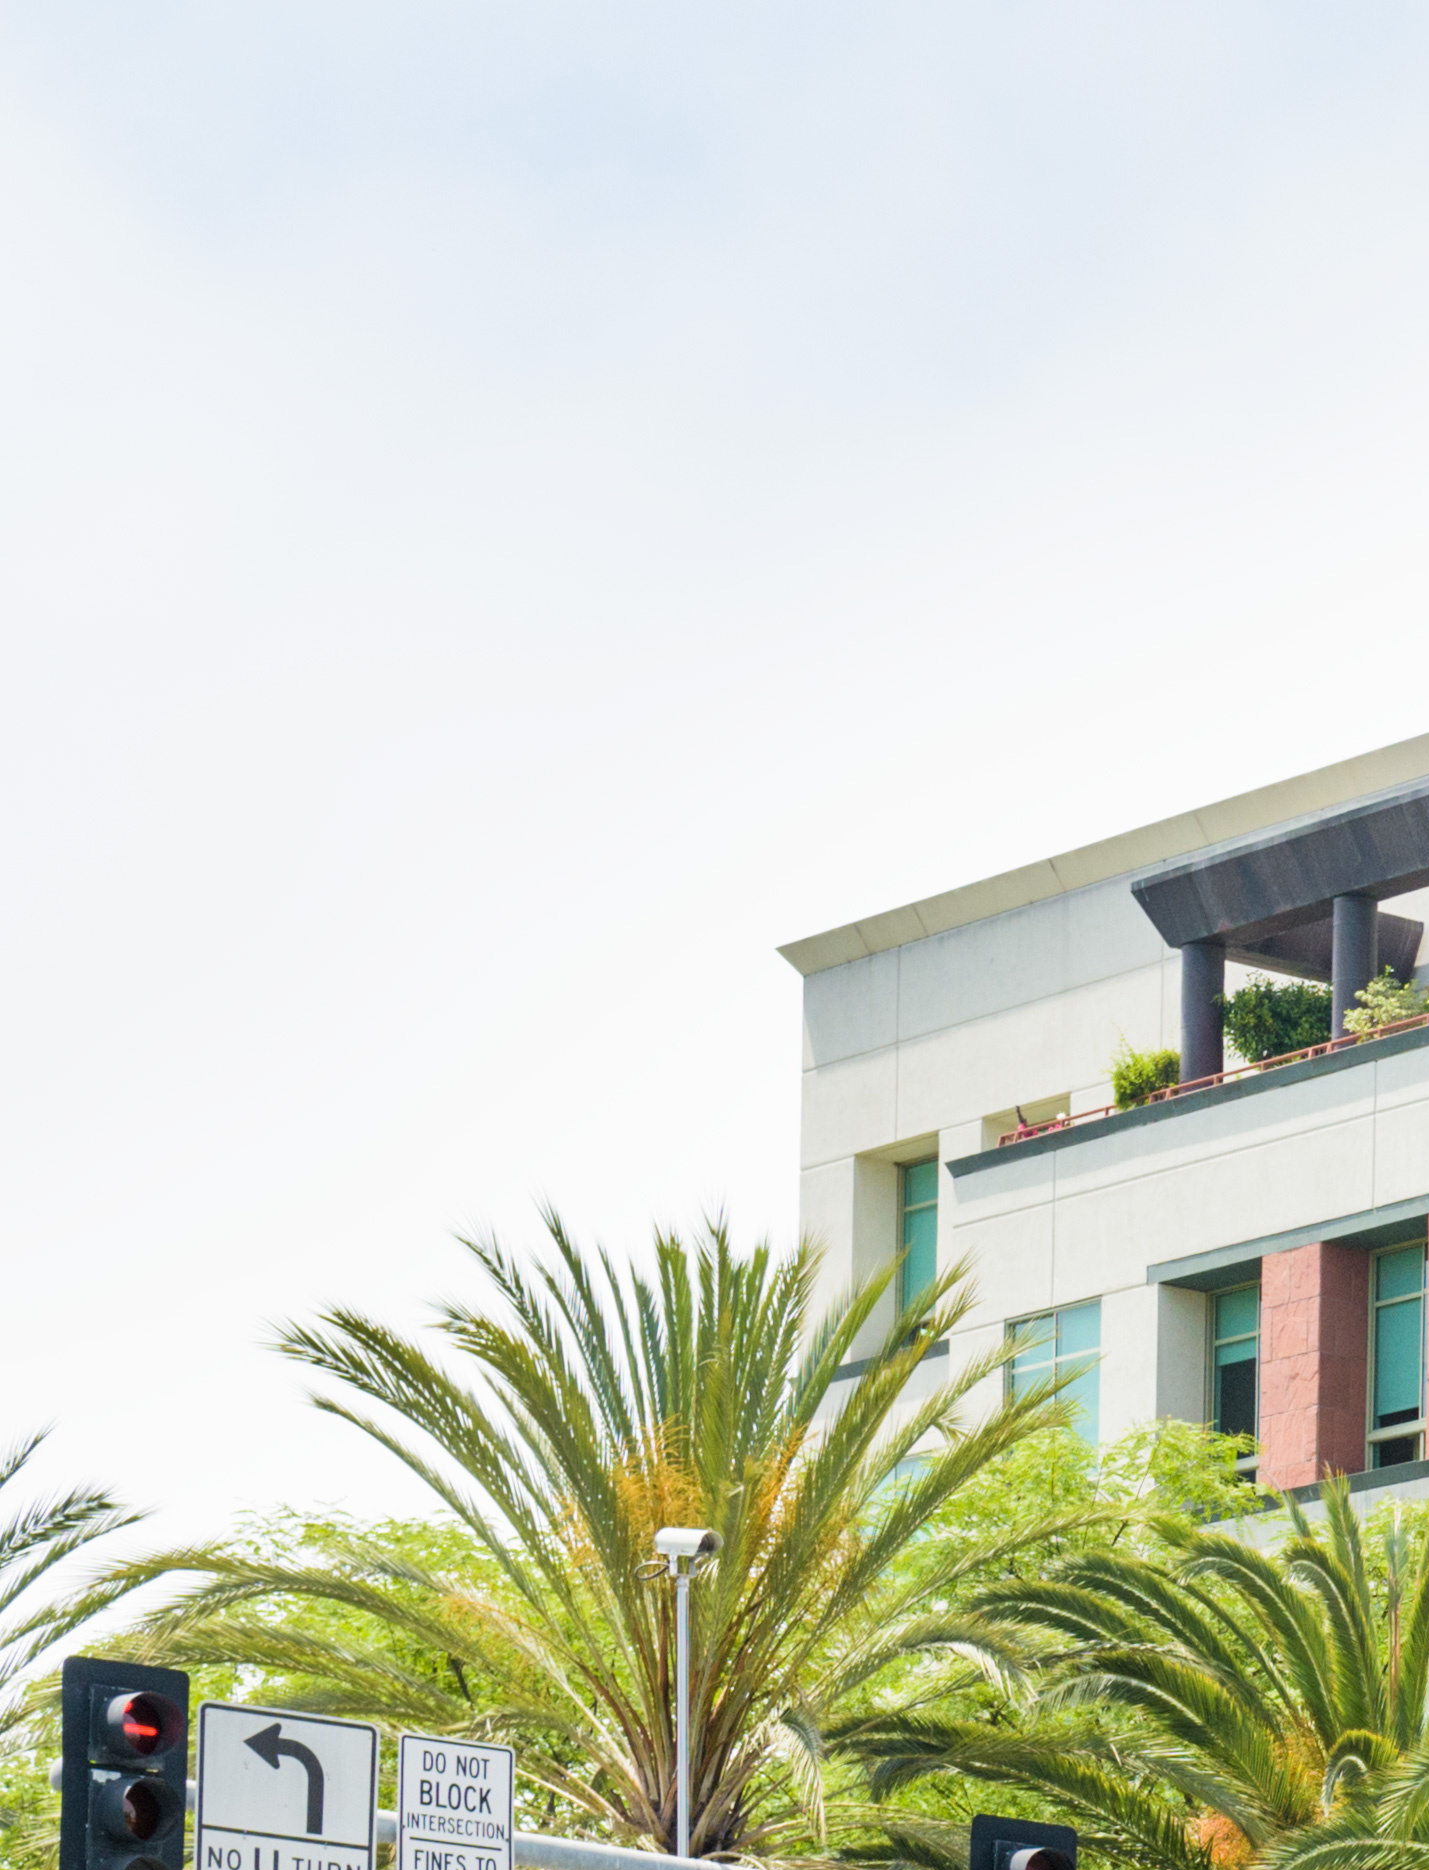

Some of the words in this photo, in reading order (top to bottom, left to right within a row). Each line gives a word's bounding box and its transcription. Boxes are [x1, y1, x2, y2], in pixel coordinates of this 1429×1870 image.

[423, 1750, 447, 1774] DO
[456, 1755, 490, 1780] NOT
[419, 1779, 492, 1814] BLOCK
[407, 1812, 505, 1840] INTERSECTION
[207, 1846, 242, 1870] NO
